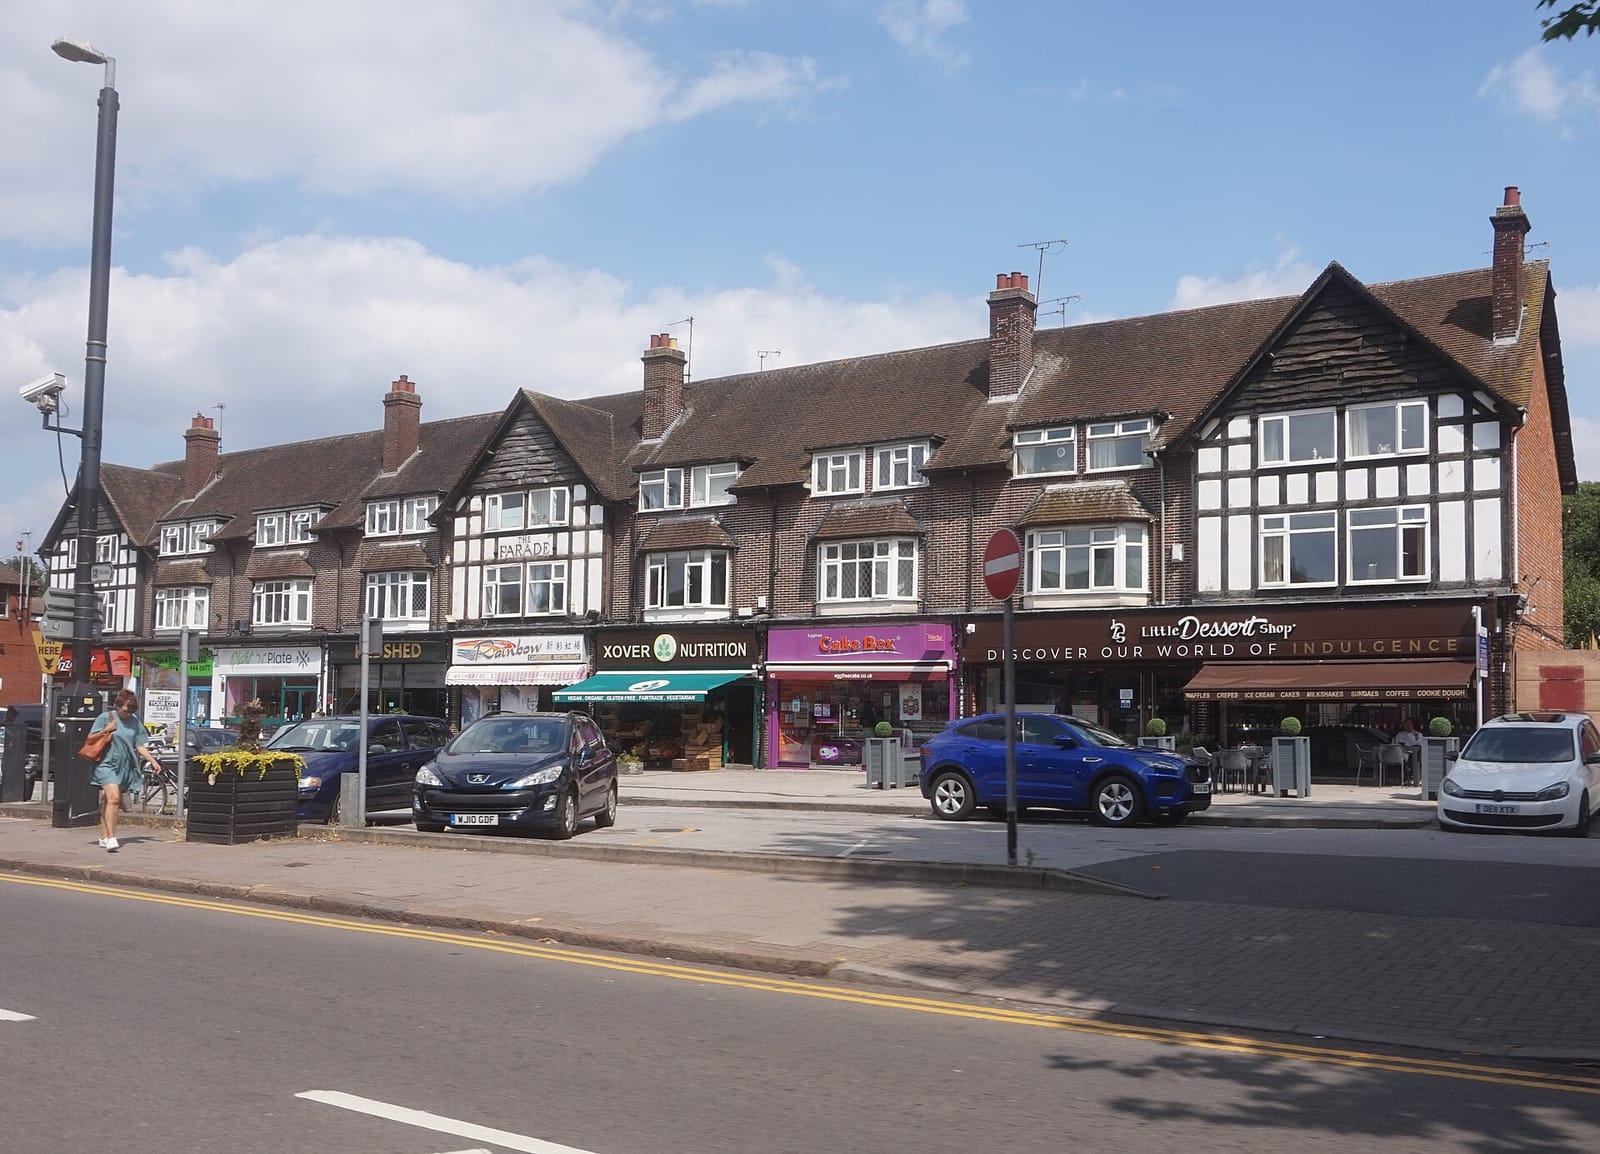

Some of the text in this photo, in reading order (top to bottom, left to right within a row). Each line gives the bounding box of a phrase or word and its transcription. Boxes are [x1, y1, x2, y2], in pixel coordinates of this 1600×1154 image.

[500, 542, 550, 557] PARADE
[1142, 615, 1293, 640] Little Dessert Shop
[38, 646, 60, 655] HERE
[474, 638, 543, 661] Rainbow
[603, 642, 747, 658] XOVER NUTRITION
[819, 635, 896, 651] Cake Box
[1101, 646, 1143, 658] OUR
[1157, 644, 1234, 657] WORLD
[1250, 643, 1277, 655] OF
[1293, 639, 1457, 654] INDULGENCE
[267, 652, 292, 664] Plate
